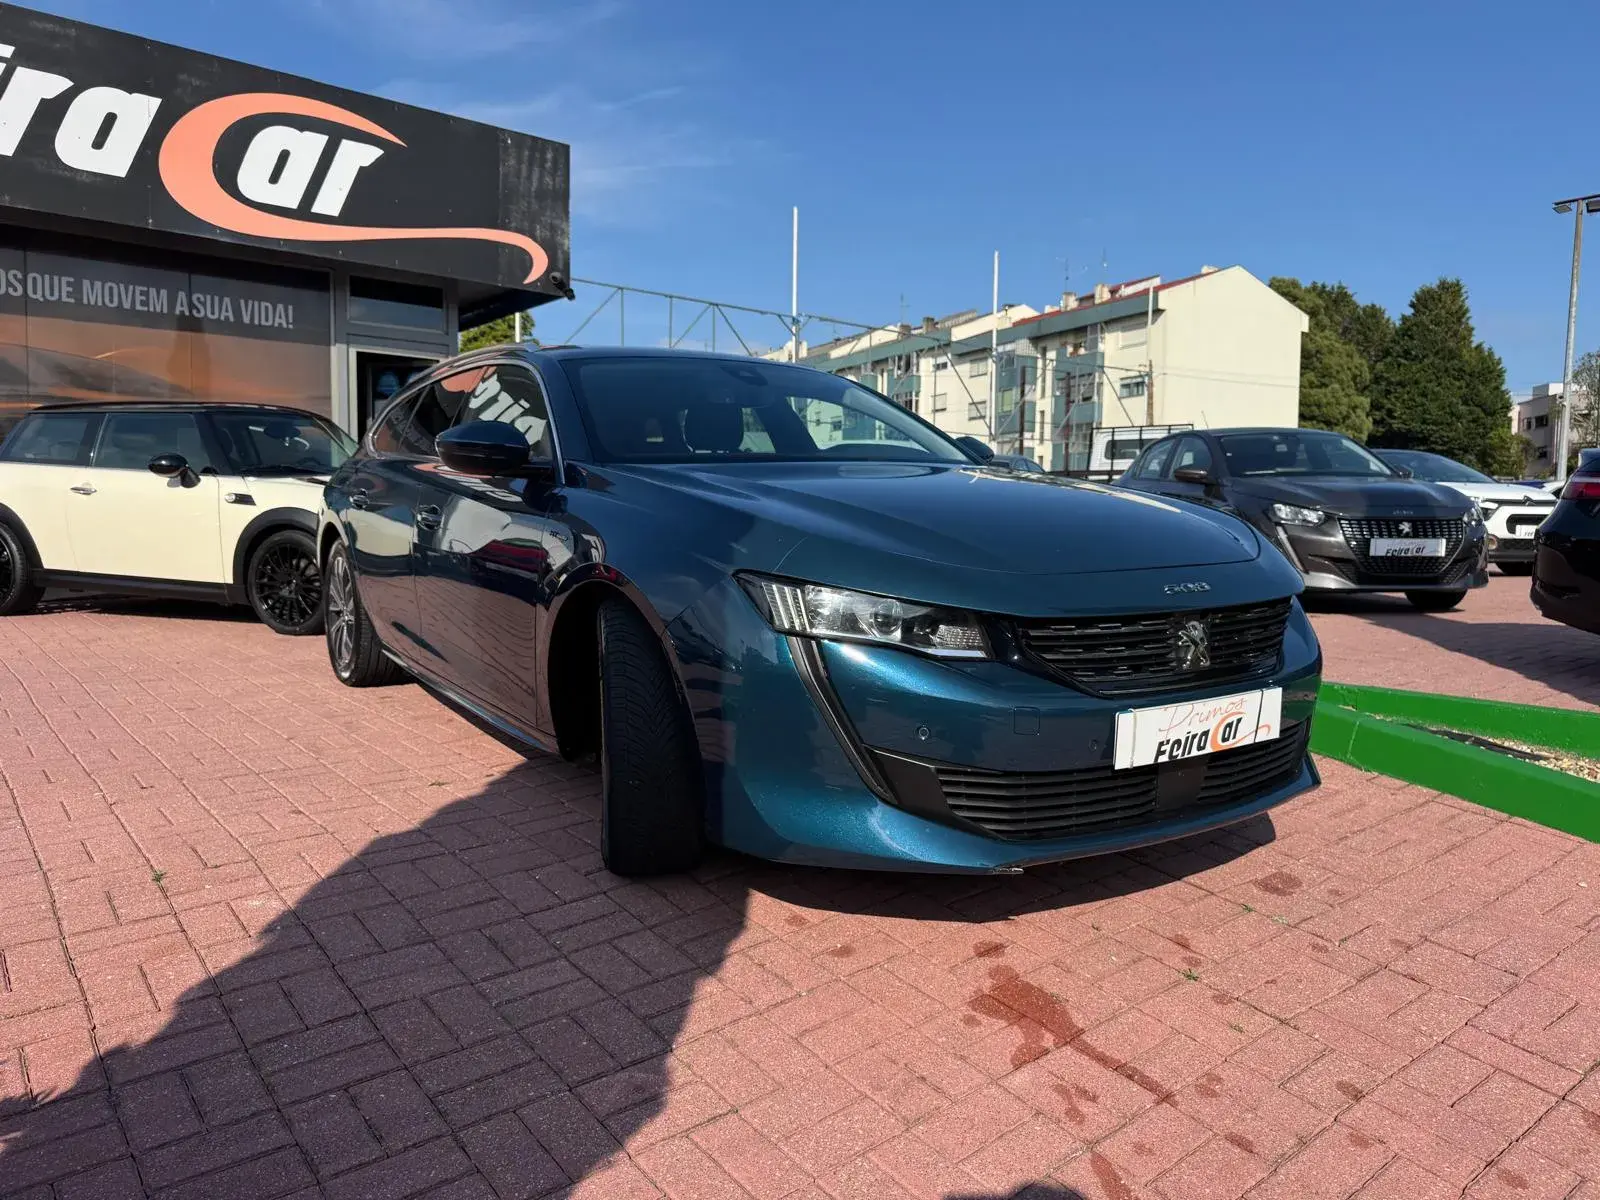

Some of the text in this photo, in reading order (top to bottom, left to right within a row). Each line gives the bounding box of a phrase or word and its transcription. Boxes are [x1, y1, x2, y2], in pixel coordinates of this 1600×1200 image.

[26, 272, 75, 303] QUE
[82, 279, 168, 314] MOVEM
[240, 299, 294, 329] VIDA!
